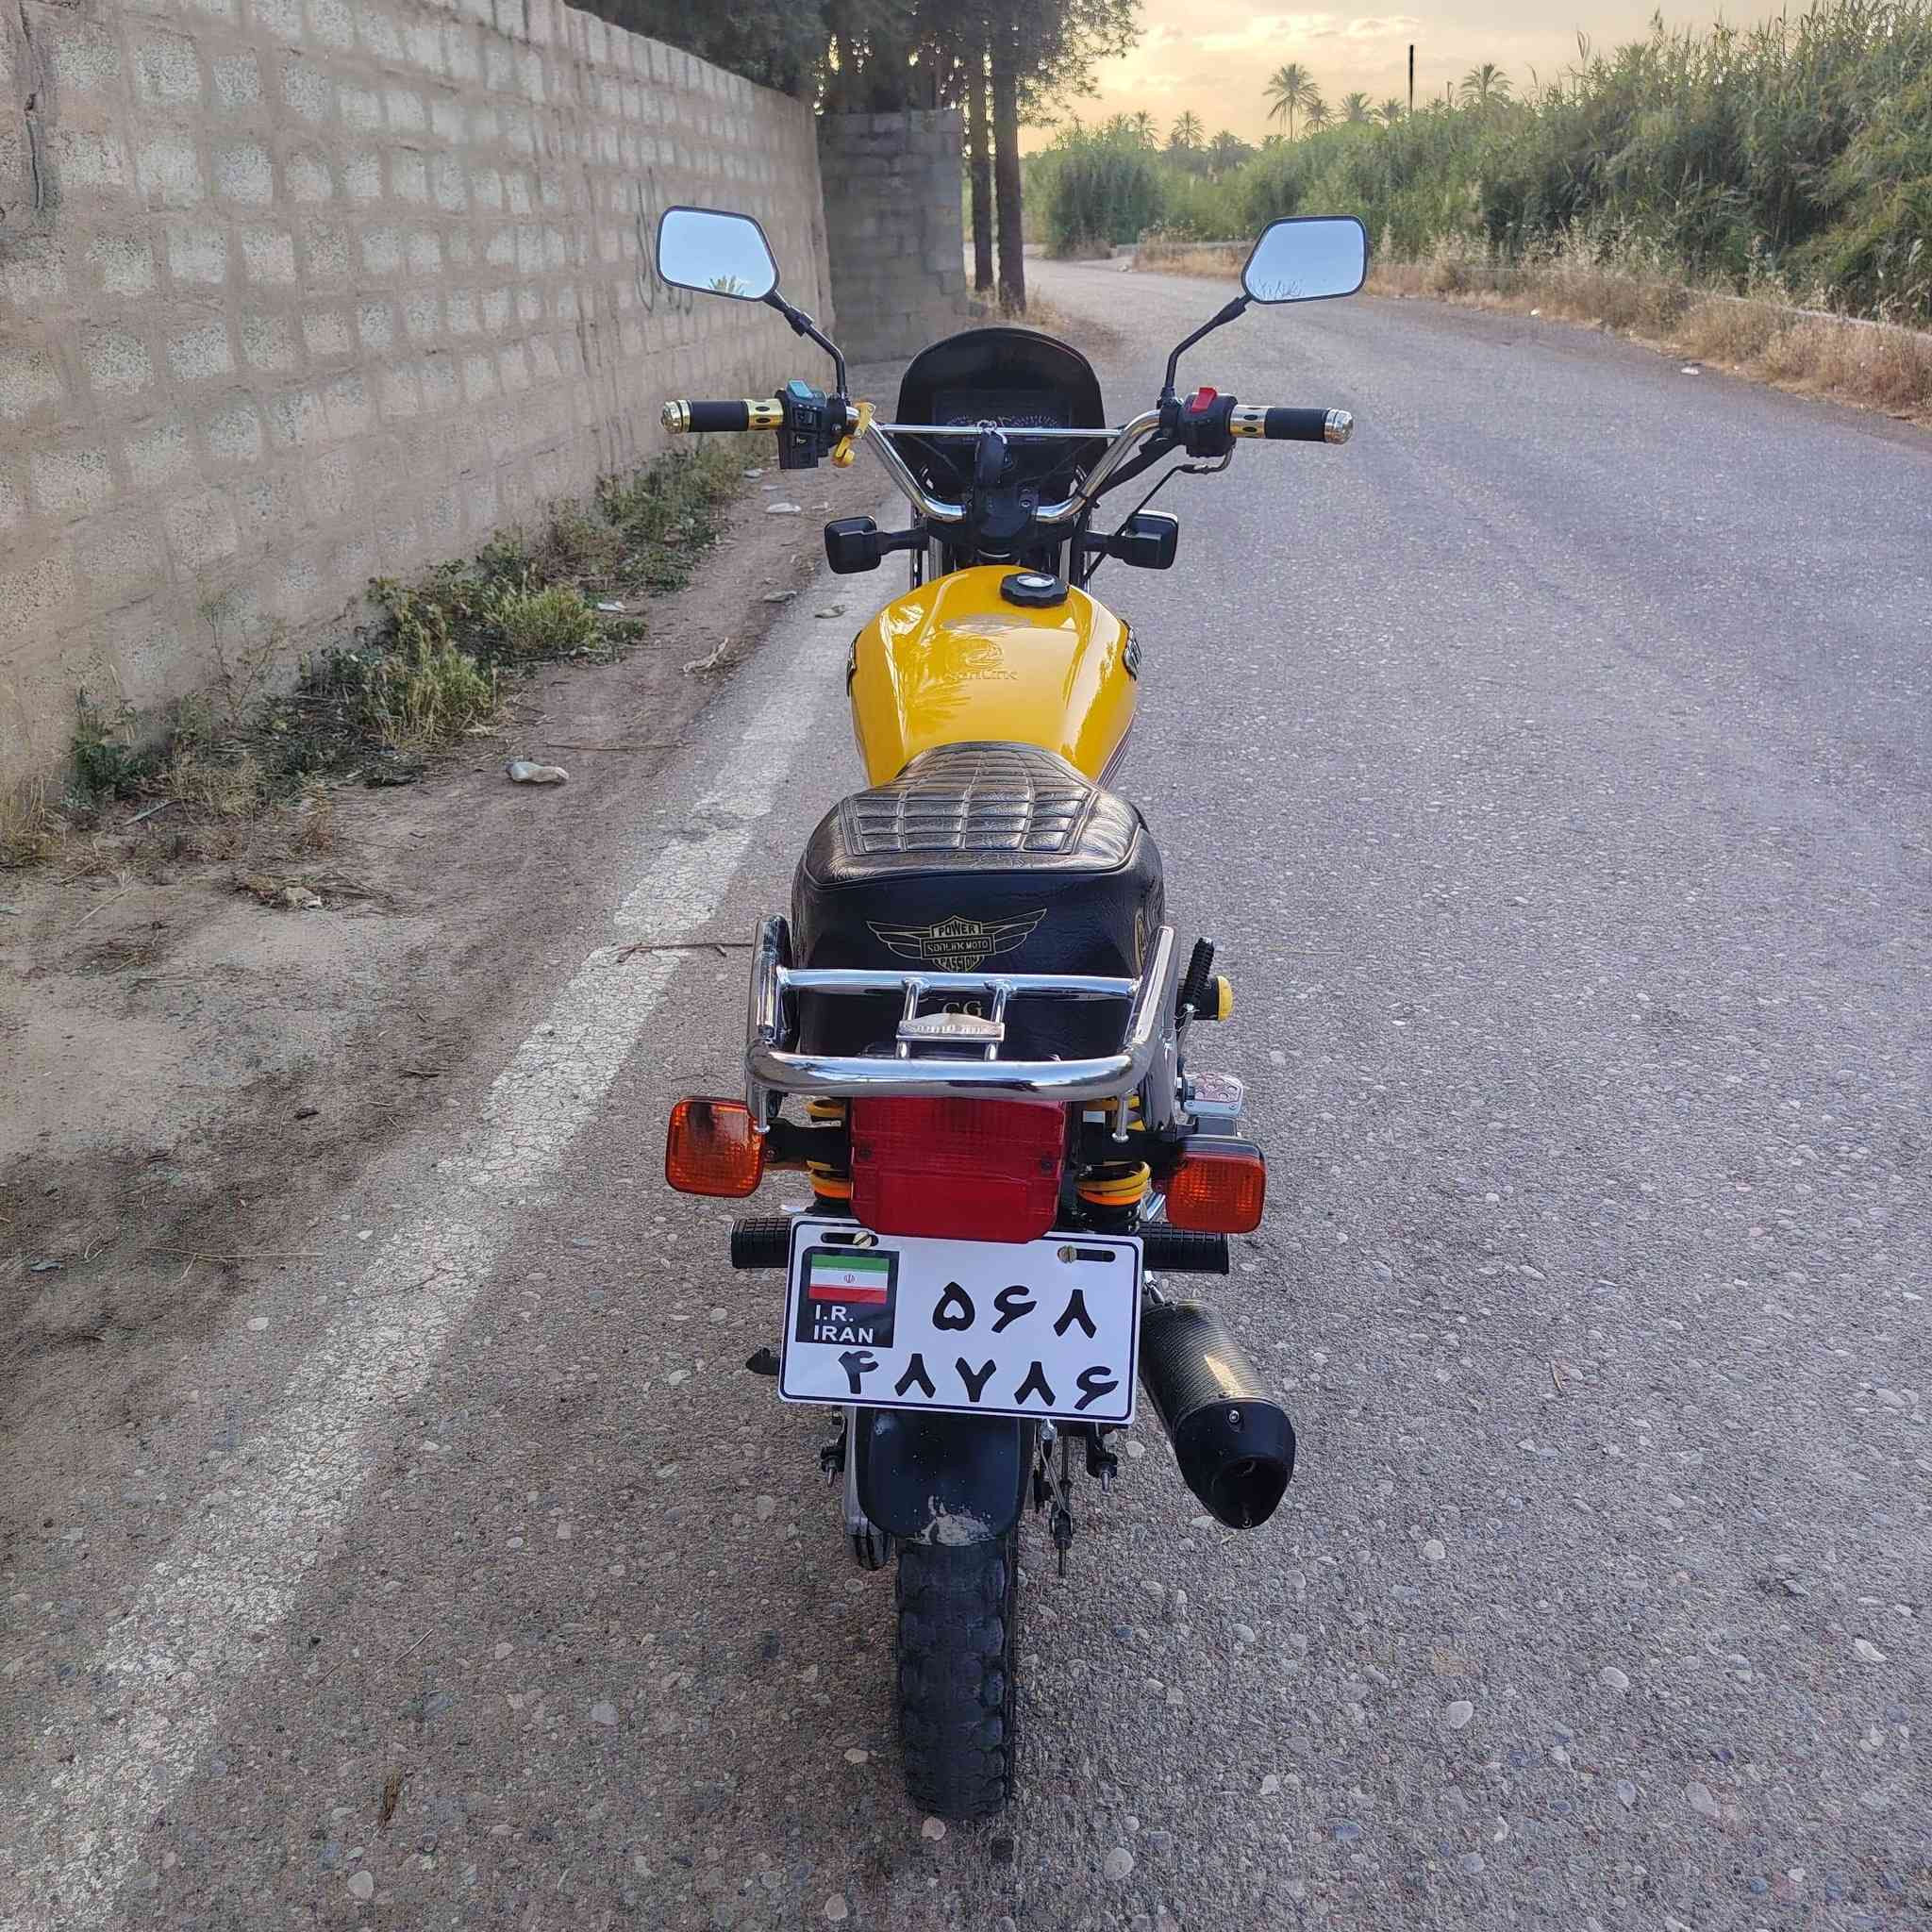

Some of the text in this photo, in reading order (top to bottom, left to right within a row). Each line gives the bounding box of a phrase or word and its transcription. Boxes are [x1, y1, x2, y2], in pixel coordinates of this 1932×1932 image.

[938, 921, 975, 937] POWER
[814, 1305, 854, 1323] I.R.
[932, 1281, 1097, 1339] ۵۶۸
[813, 1324, 874, 1344] IRAN
[839, 1350, 1120, 1411] ۴۸۷۸۶
